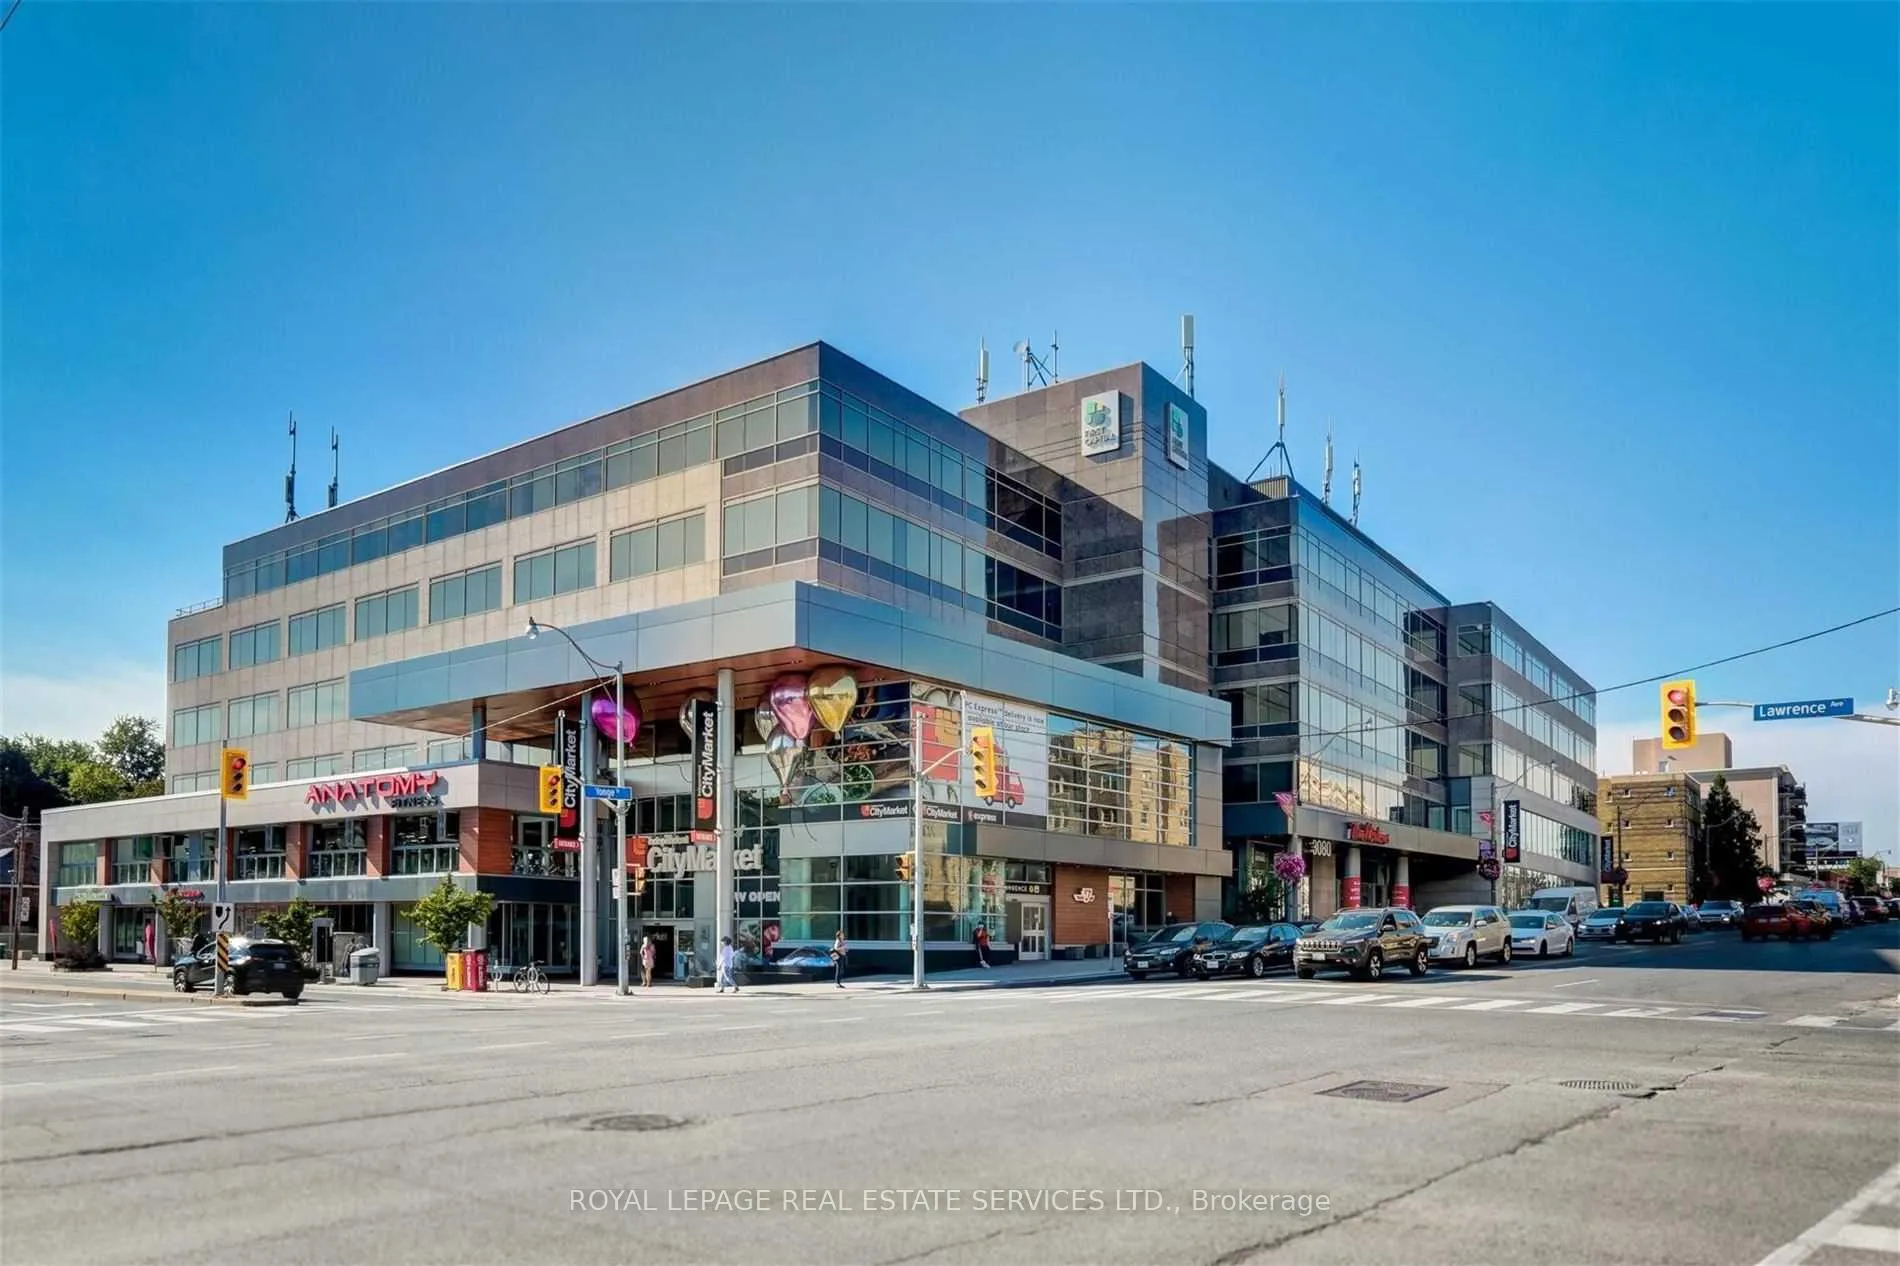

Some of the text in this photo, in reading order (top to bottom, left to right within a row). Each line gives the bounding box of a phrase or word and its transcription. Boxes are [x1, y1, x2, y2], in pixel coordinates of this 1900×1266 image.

[1759, 704, 1826, 717] Lawrence
[701, 711, 715, 797] CityMarket
[564, 729, 578, 808] CityMarket
[304, 772, 438, 804] ANATOMY
[869, 805, 908, 816] CityMarket
[1508, 805, 1518, 847] CityMarket
[1313, 840, 1332, 857] 3080
[748, 890, 781, 902] OPEN
